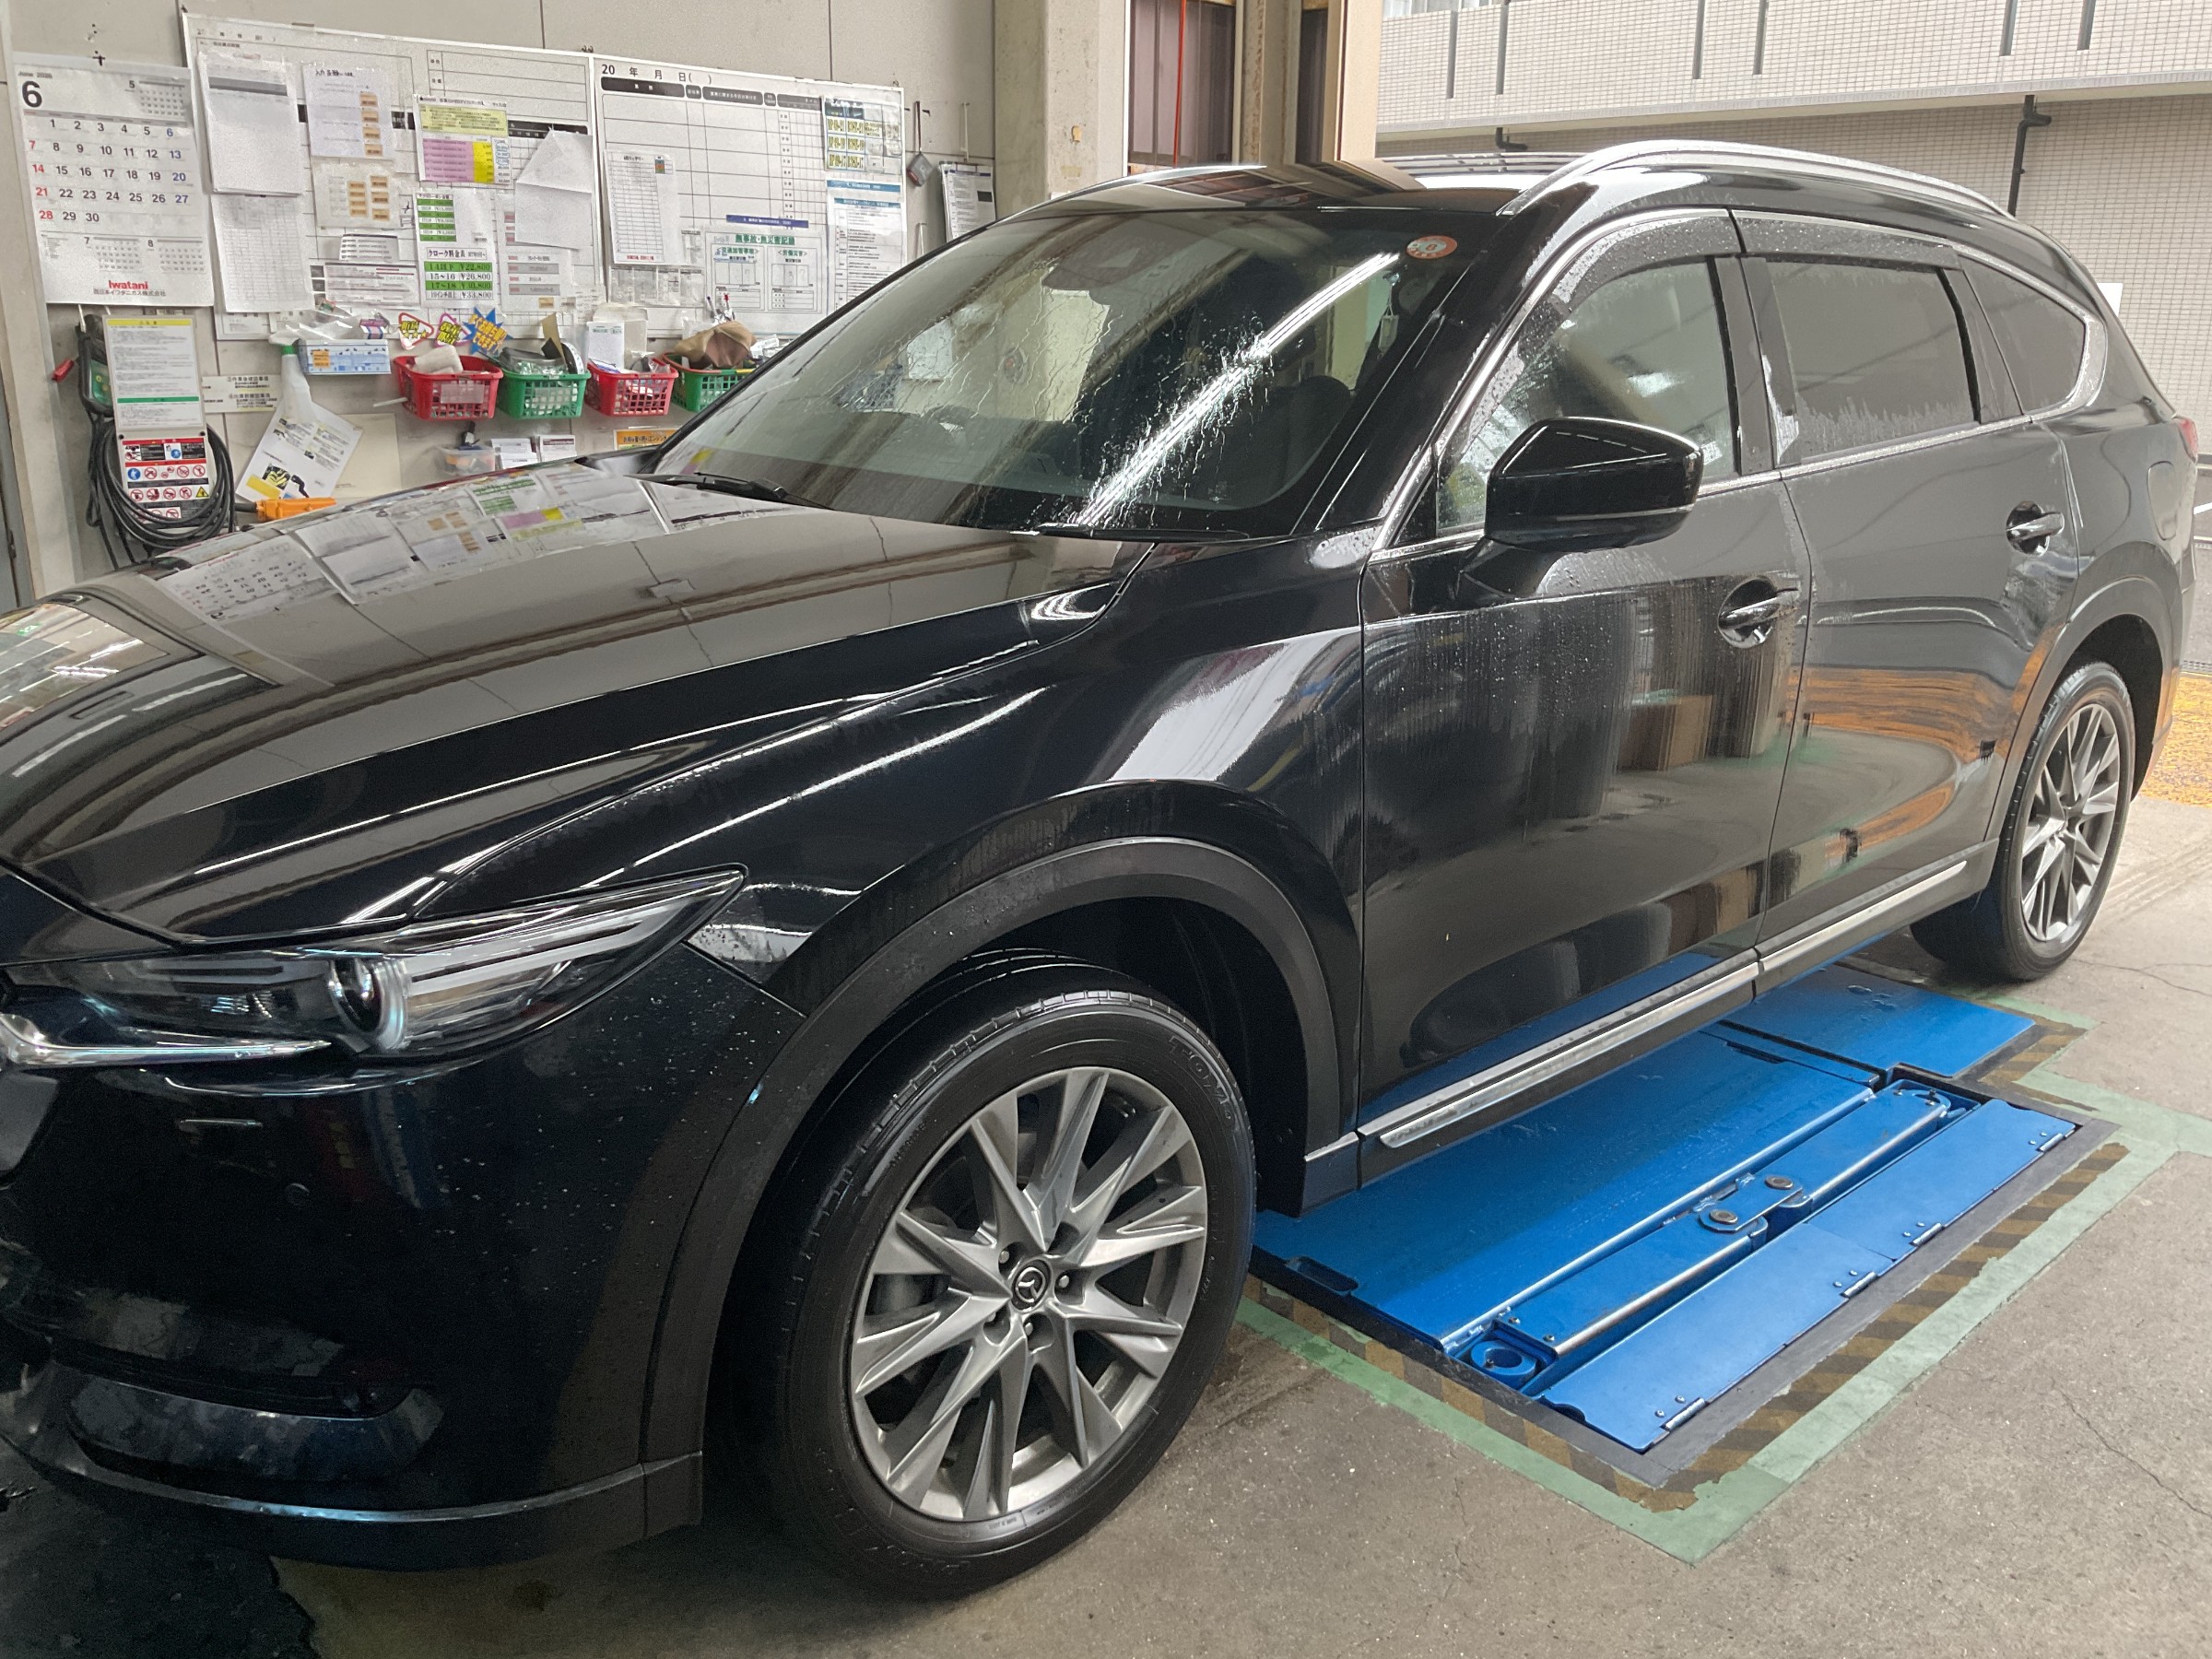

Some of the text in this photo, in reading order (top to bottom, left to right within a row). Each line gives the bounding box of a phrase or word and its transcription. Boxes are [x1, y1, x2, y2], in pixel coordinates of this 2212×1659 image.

[602, 65, 615, 75] 20
[629, 66, 638, 77] 年
[654, 70, 663, 80] 月
[129, 80, 135, 88] 5
[22, 81, 41, 107] 6
[75, 121, 81, 129] 2
[98, 123, 104, 131] 3
[145, 126, 150, 135] 5
[167, 128, 173, 136] 6
[29, 140, 181, 159] 7 8 9 10 11 12 13
[32, 164, 44, 172] 14
[56, 166, 67, 174] 15
[80, 168, 91, 176] 16
[104, 169, 114, 177] 17
[127, 171, 137, 179] 18
[36, 187, 47, 196] 21
[60, 189, 73, 197] 22
[83, 191, 96, 199] 23
[107, 192, 119, 200] 24
[129, 193, 142, 202] 25
[152, 194, 165, 203] 26
[40, 210, 99, 221] 28 29 30
[108, 280, 148, 290] Iwatani
